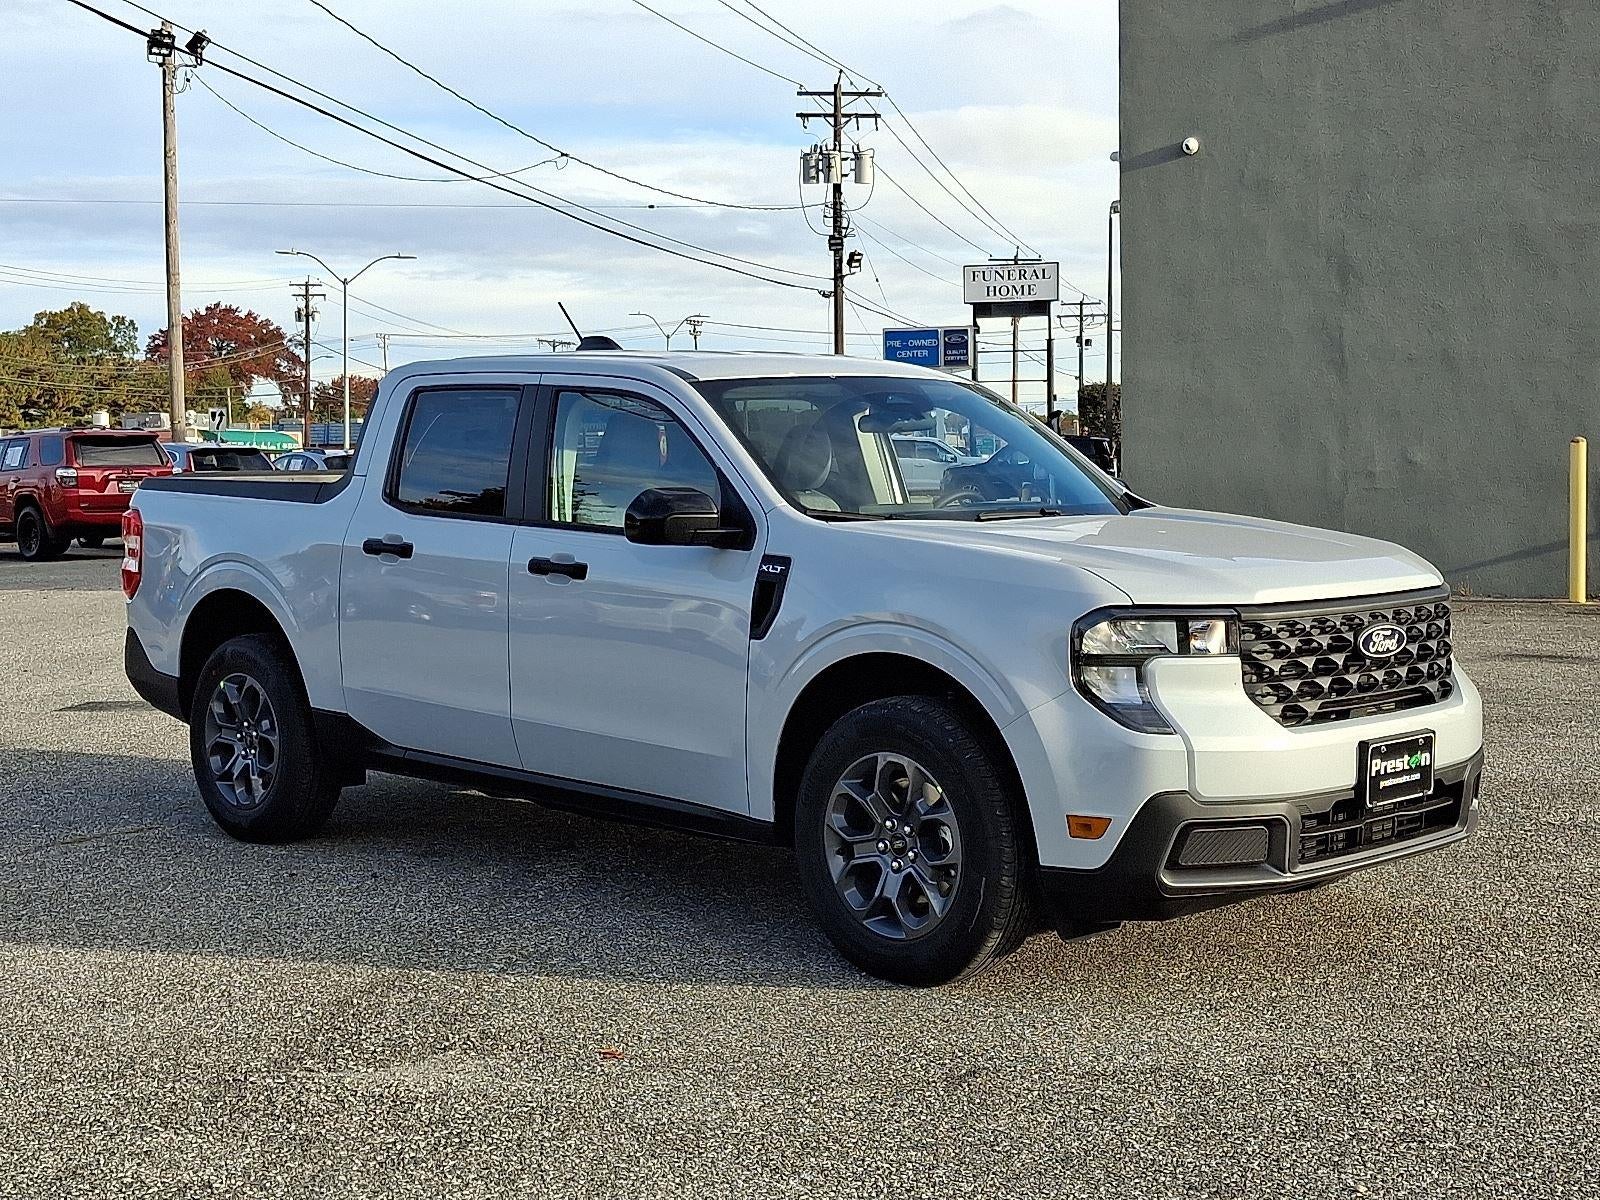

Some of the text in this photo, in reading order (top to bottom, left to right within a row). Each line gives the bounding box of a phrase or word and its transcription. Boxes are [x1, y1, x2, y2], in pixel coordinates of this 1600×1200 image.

[971, 268, 1052, 283] FUNERAL
[985, 284, 1038, 297] HOME
[896, 349, 929, 358] CENTER
[759, 564, 786, 574] XLT
[1368, 629, 1400, 654] Ford
[1371, 750, 1431, 777] Preston
